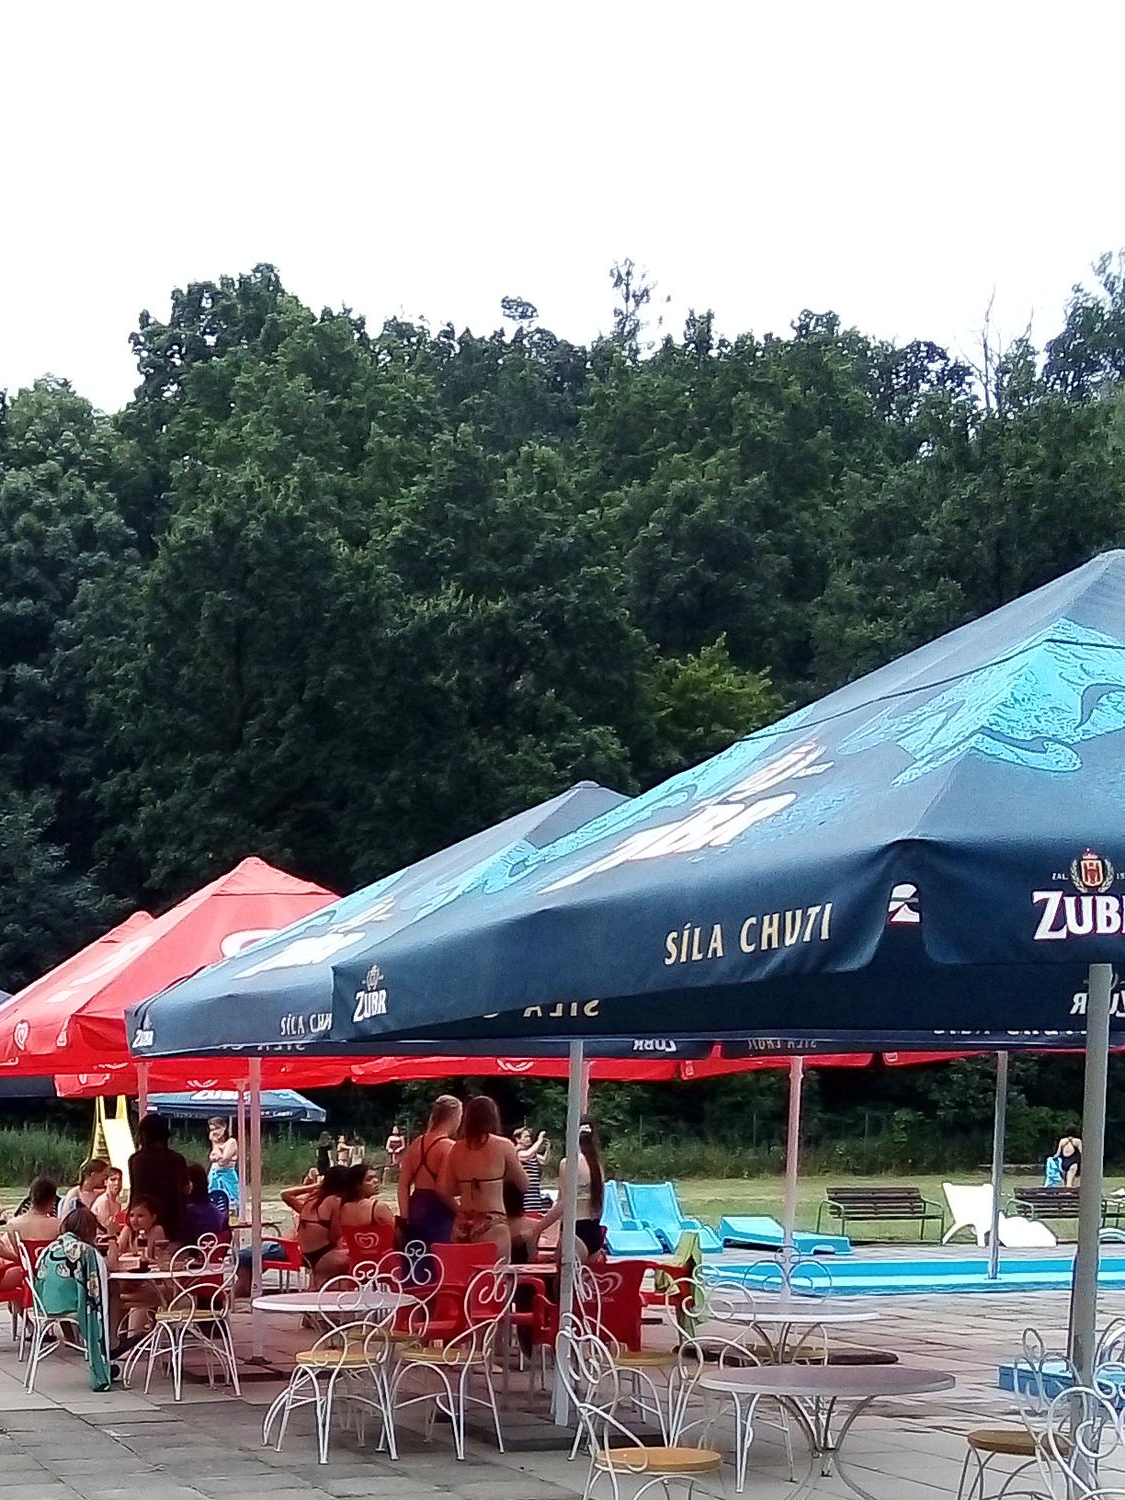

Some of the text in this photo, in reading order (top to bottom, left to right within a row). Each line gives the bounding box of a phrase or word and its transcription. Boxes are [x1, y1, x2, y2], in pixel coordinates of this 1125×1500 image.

[664, 922, 724, 965] SÍLA
[739, 902, 833, 954] CHUTI
[1032, 891, 1125, 940] ZUB
[280, 1013, 306, 1036] SÍLA
[352, 988, 387, 1023] ZUBR
